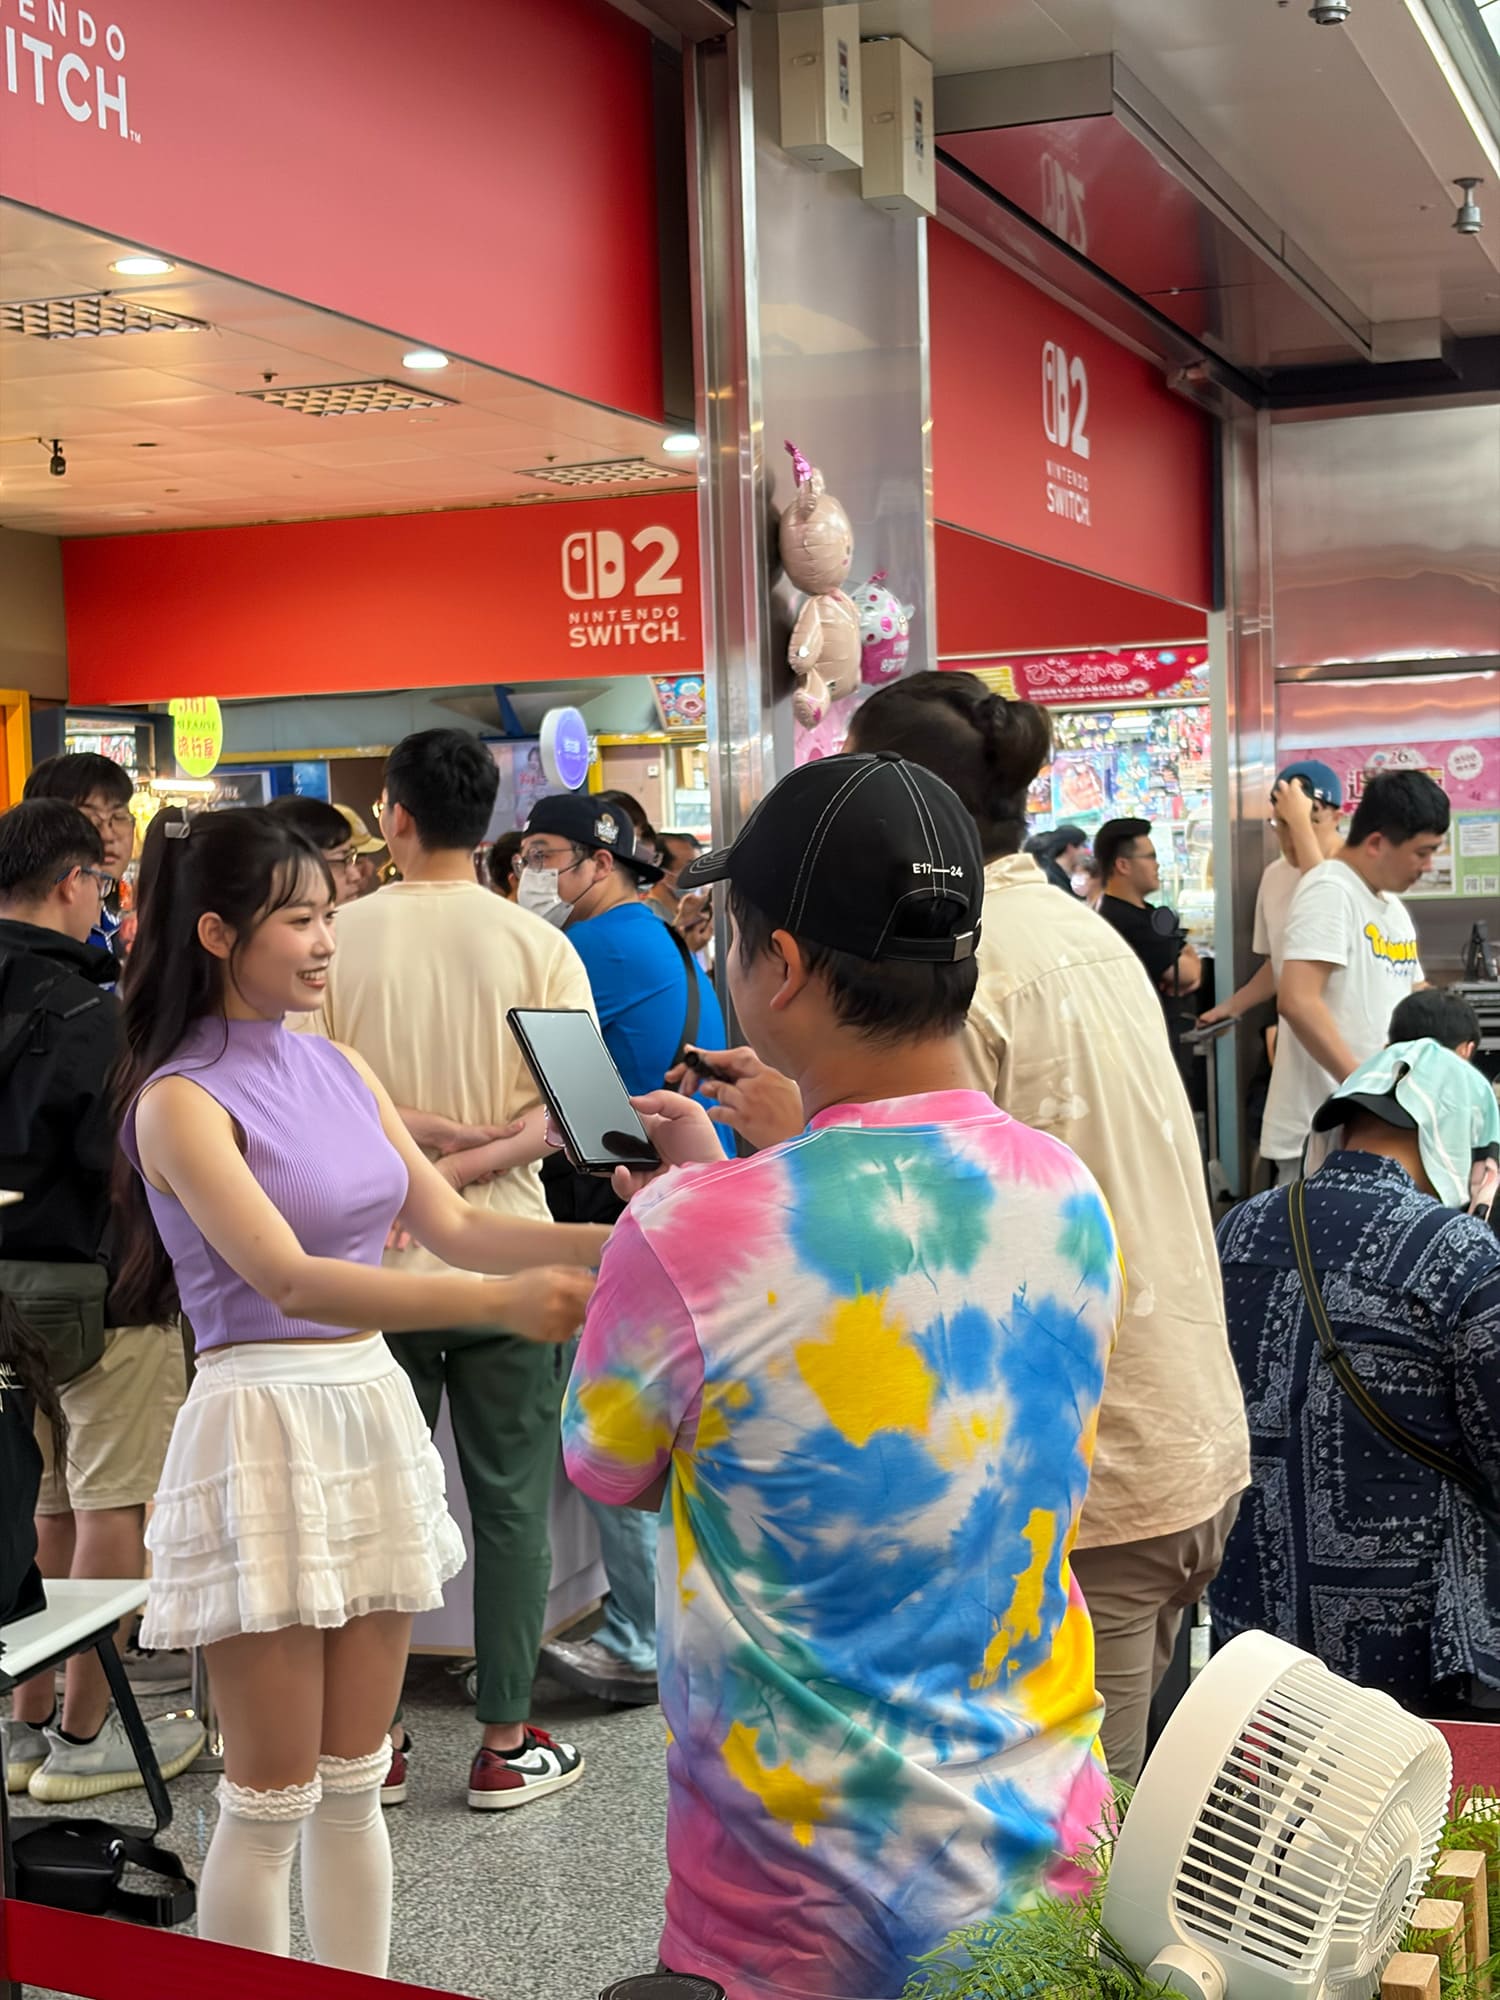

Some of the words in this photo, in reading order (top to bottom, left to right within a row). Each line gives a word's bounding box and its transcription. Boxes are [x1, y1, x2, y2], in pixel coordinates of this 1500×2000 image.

[1070, 356, 1090, 460] 2
[1046, 459, 1089, 492] NINTENDO
[1046, 482, 1091, 527] SWITCH
[631, 525, 683, 597] 2
[568, 606, 680, 625] NINTENDO
[569, 621, 680, 648] SWITCH
